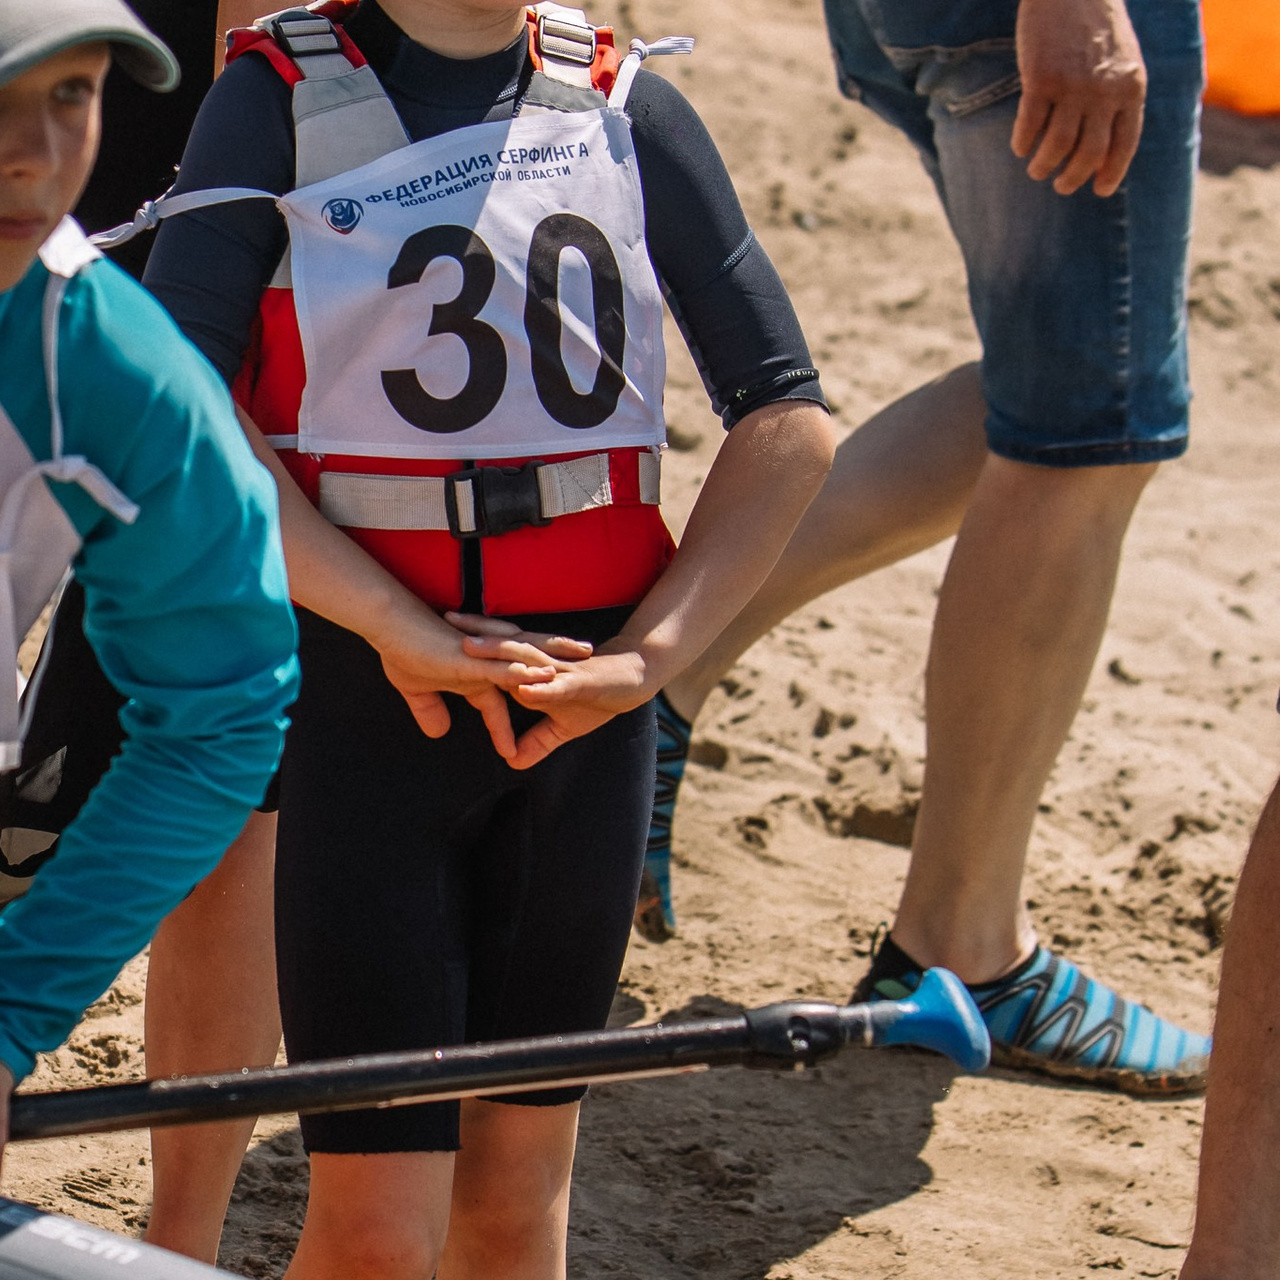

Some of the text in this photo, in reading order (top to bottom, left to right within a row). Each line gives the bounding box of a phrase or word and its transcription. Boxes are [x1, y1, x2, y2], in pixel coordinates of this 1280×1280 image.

[365, 142, 589, 203] ФЕДЕРАЦИЯ СЕРФИНГА
[400, 165, 571, 208] НОВОСИБИРСКОЙ ОБЛАСТИ
[381, 213, 626, 434] 30
